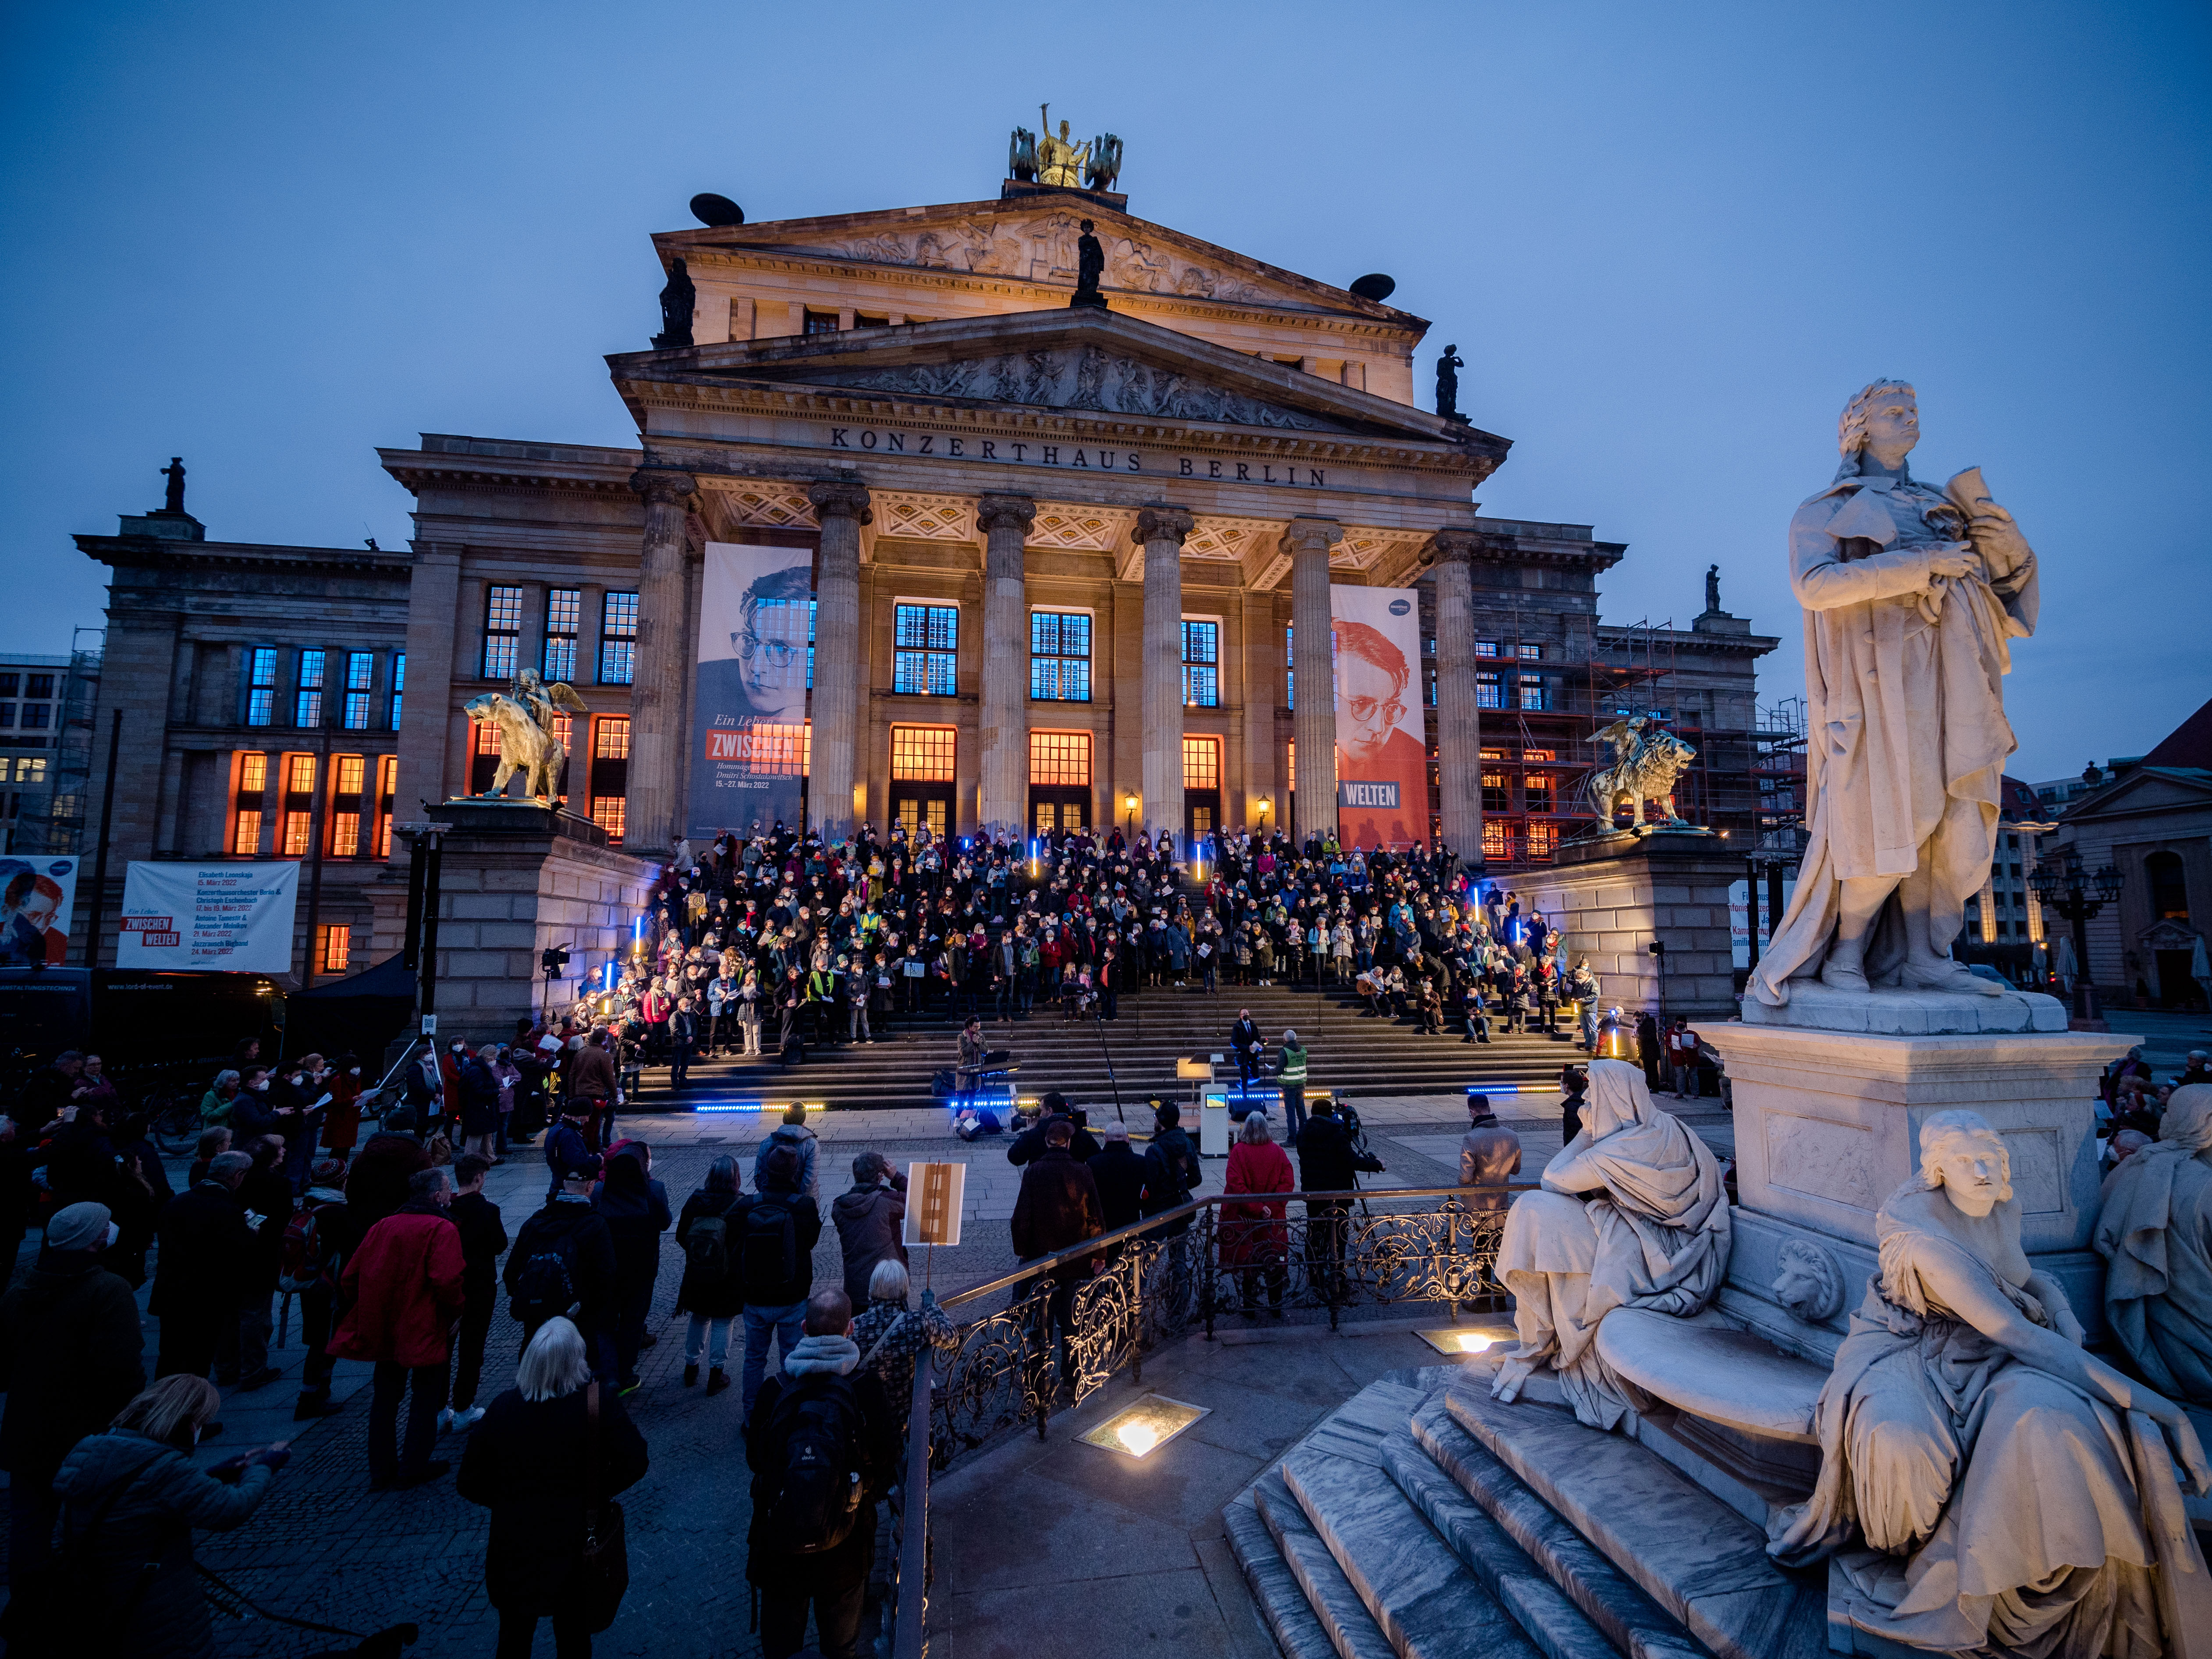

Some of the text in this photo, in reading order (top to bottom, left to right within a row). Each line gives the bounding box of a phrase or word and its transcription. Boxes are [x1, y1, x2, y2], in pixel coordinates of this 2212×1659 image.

[831, 428, 1324, 486] KONZERTHAUS BERLIN
[714, 714, 773, 726] Ein Leben
[712, 734, 794, 759] ZWISCHEN
[717, 763, 750, 772] Hommage
[740, 772, 793, 780] Schostakowitsch
[1345, 784, 1395, 806] WELTEN
[125, 918, 170, 930] ZWISCHEN
[146, 933, 178, 945] WELTEN
